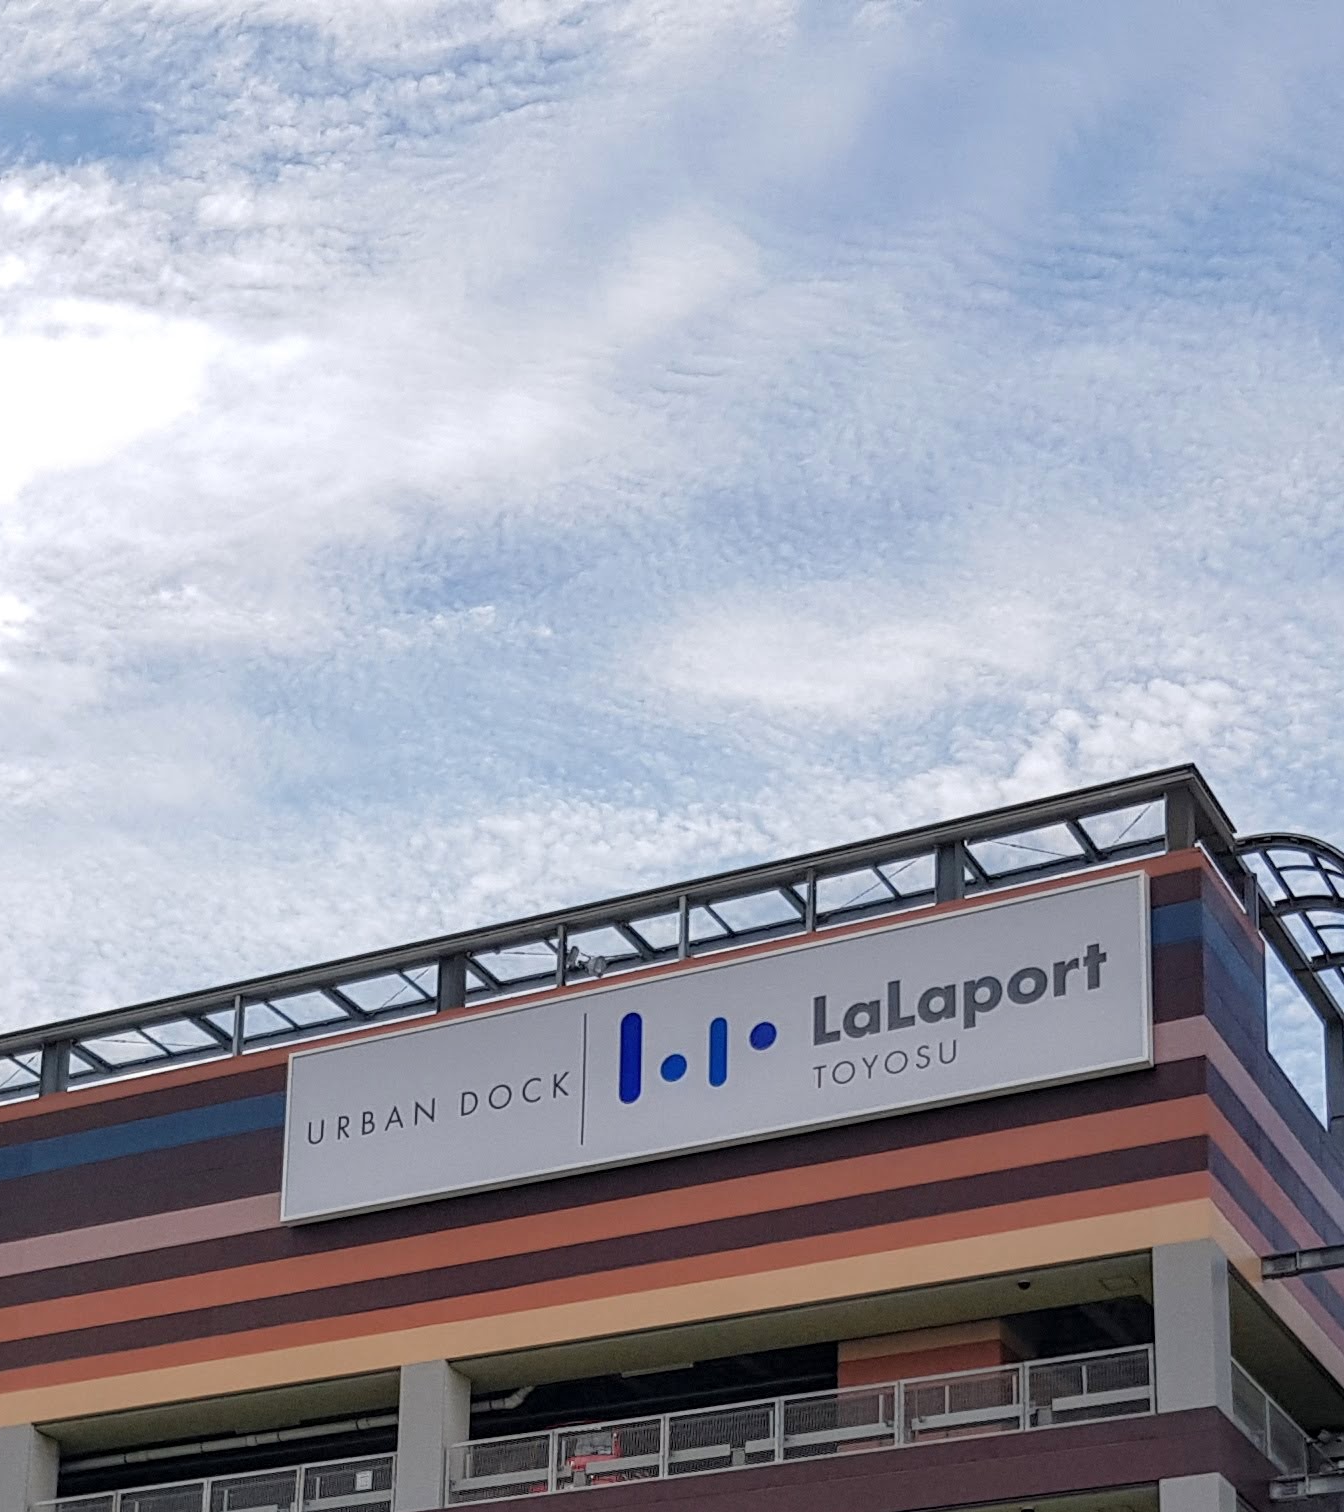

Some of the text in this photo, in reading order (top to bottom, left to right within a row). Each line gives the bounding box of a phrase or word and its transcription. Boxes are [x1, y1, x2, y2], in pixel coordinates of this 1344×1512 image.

[812, 942, 1109, 1047] LaLaport
[813, 1039, 960, 1090] TOYOSU
[307, 1070, 572, 1146] URBAN DOCK
